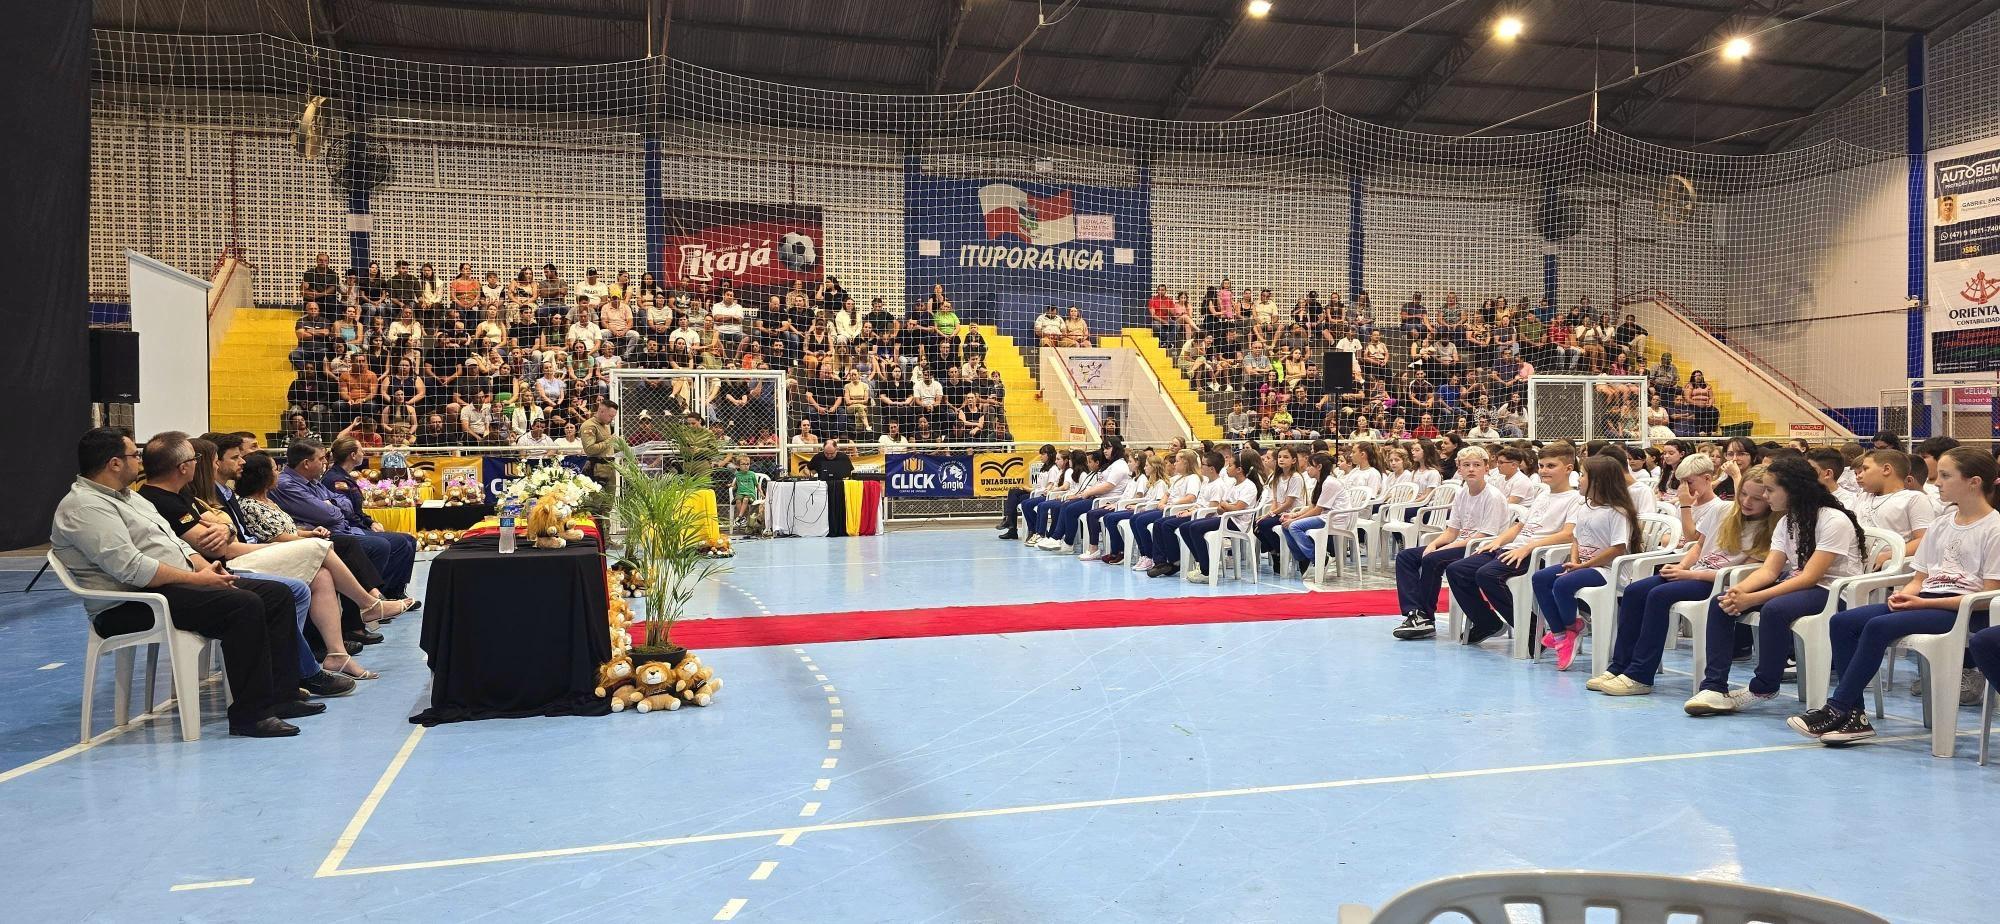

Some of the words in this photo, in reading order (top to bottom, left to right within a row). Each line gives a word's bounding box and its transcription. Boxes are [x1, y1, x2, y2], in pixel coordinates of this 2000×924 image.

[1941, 162, 2000, 184] AUTOBEM
[689, 239, 772, 276] itajá
[959, 244, 1104, 271] ITUPORANGA
[1949, 304, 2000, 320] ORIENTA
[891, 473, 936, 490] CLICK
[942, 480, 964, 491] anglo
[980, 478, 1024, 486] UNIASSELVI
